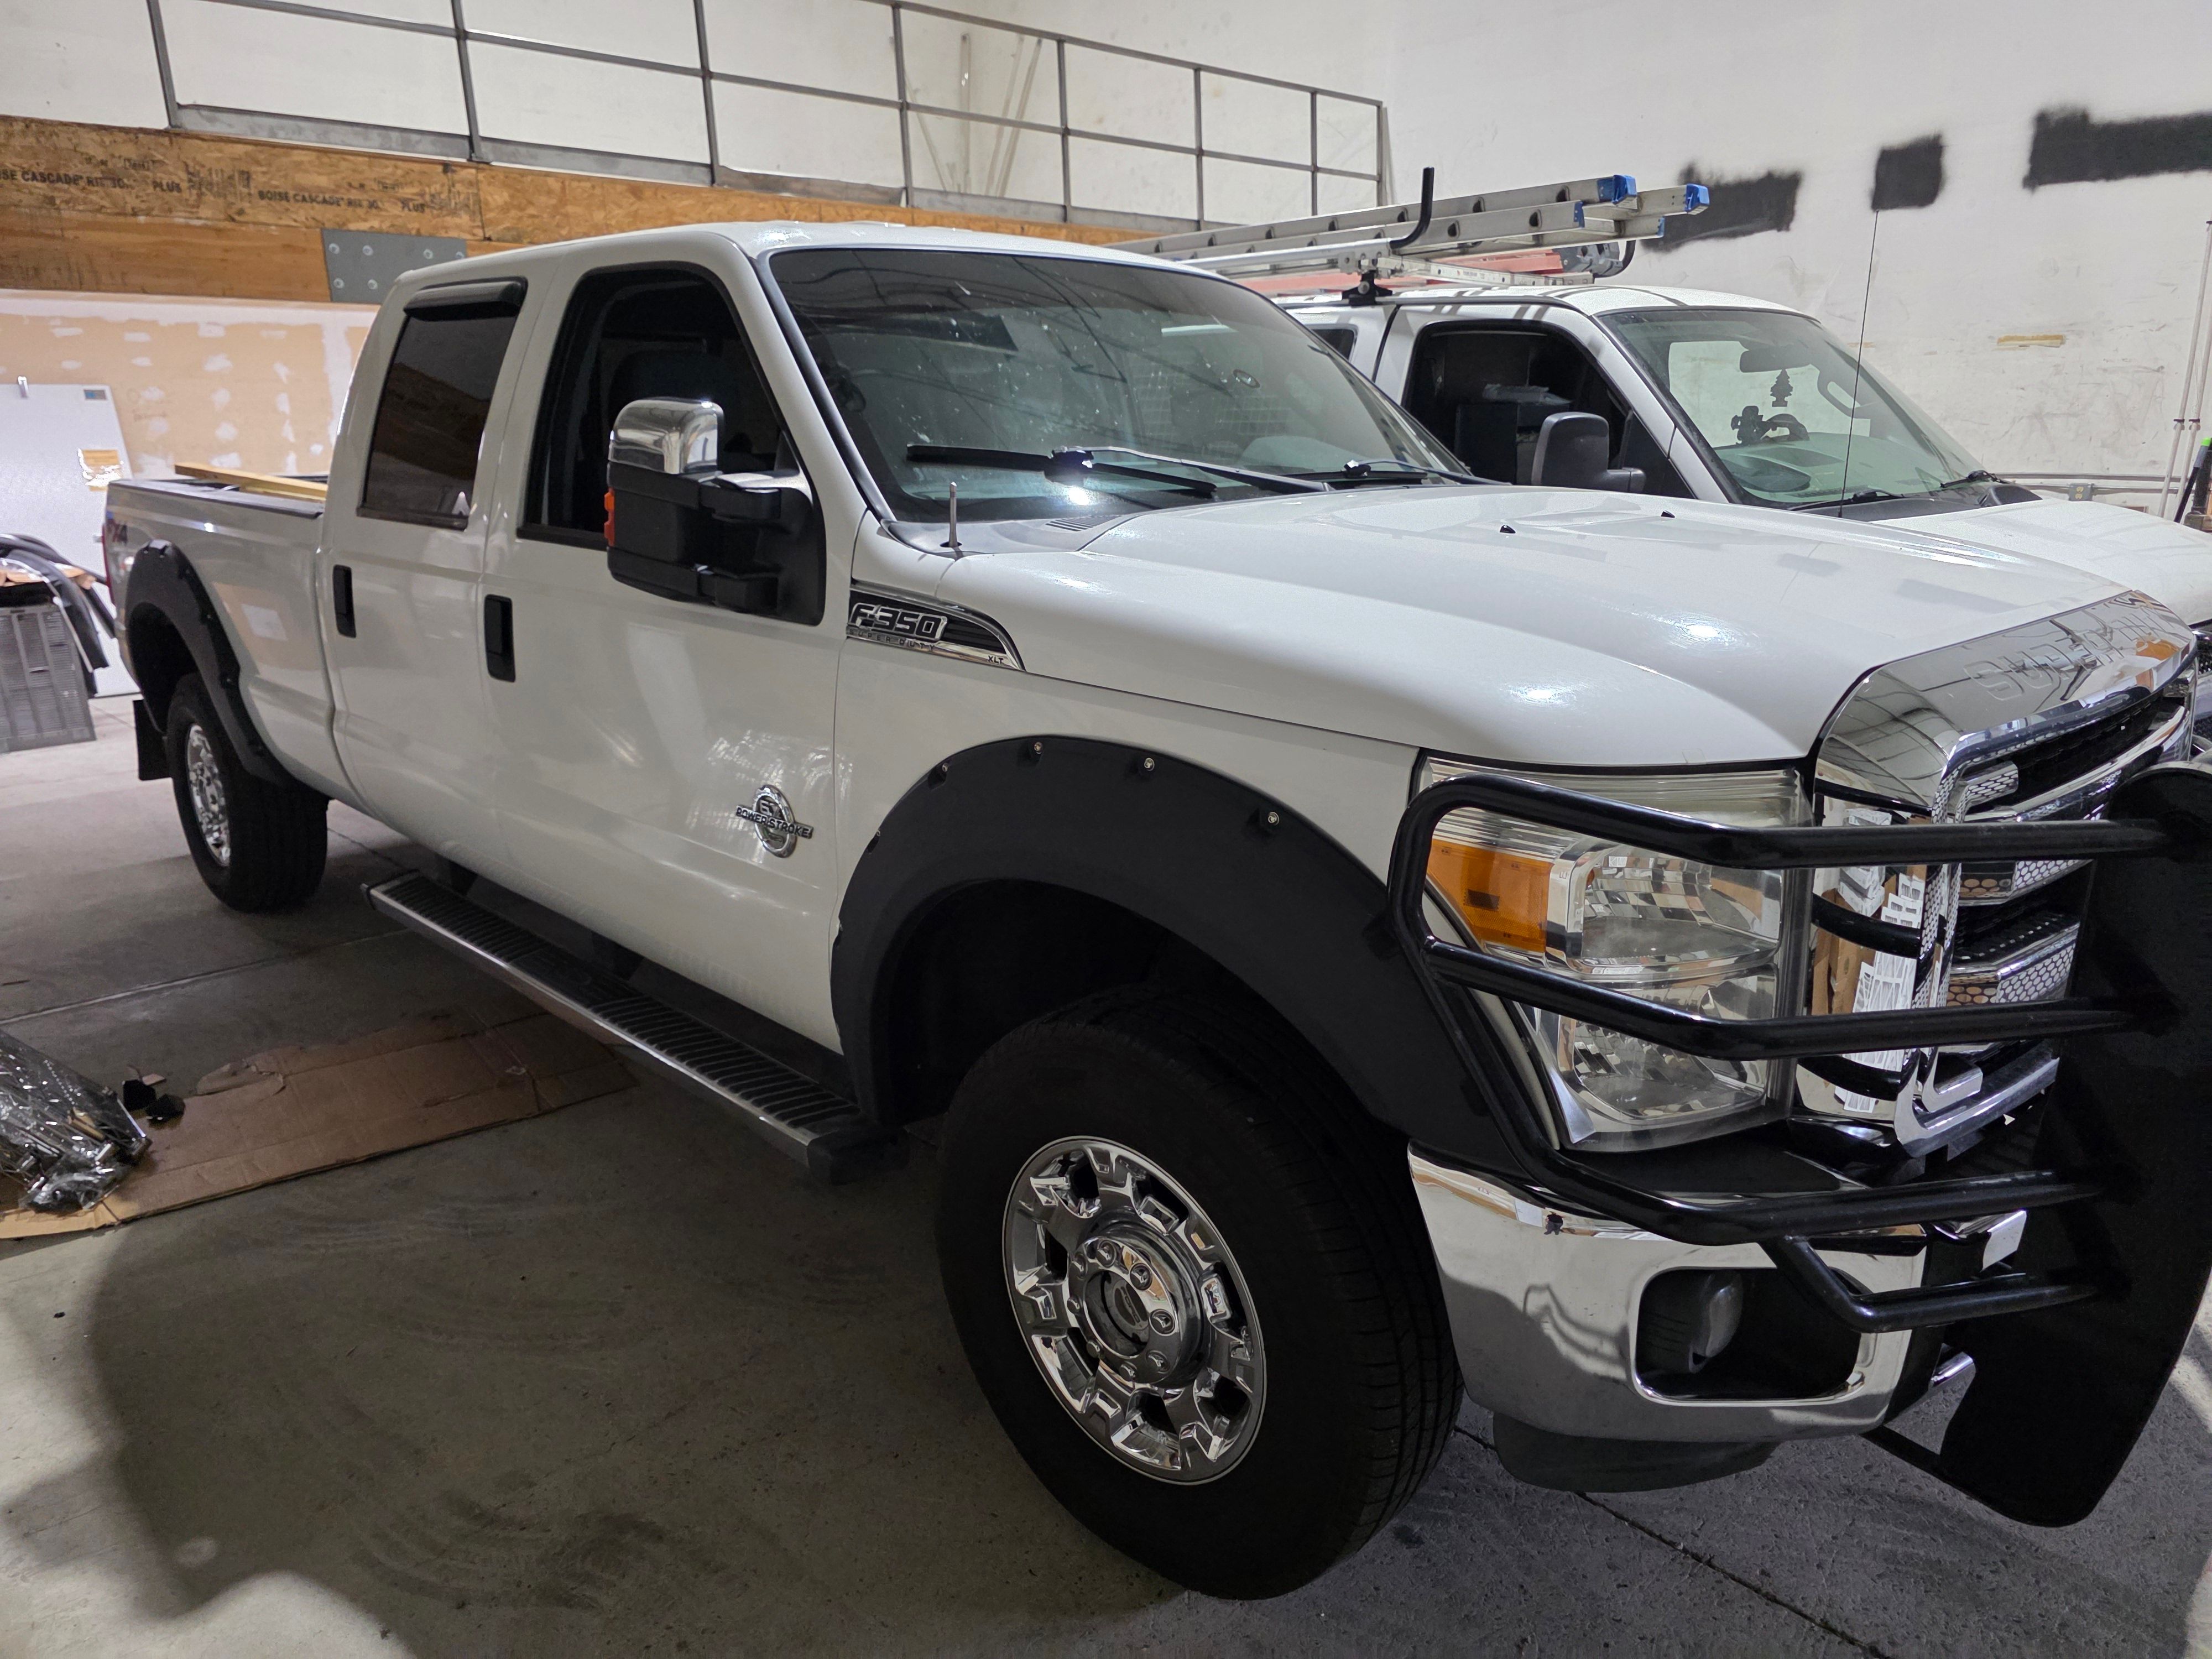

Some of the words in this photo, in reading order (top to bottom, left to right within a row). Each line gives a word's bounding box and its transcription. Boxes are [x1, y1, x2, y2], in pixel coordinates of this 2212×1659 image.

[21, 171, 81, 186] CASCADE
[258, 190, 290, 203] BOISE
[849, 628, 892, 643] SUPER
[899, 638, 936, 651] DUTY
[988, 655, 1004, 664] XLT
[1120, 1286, 1141, 1323] FORD
